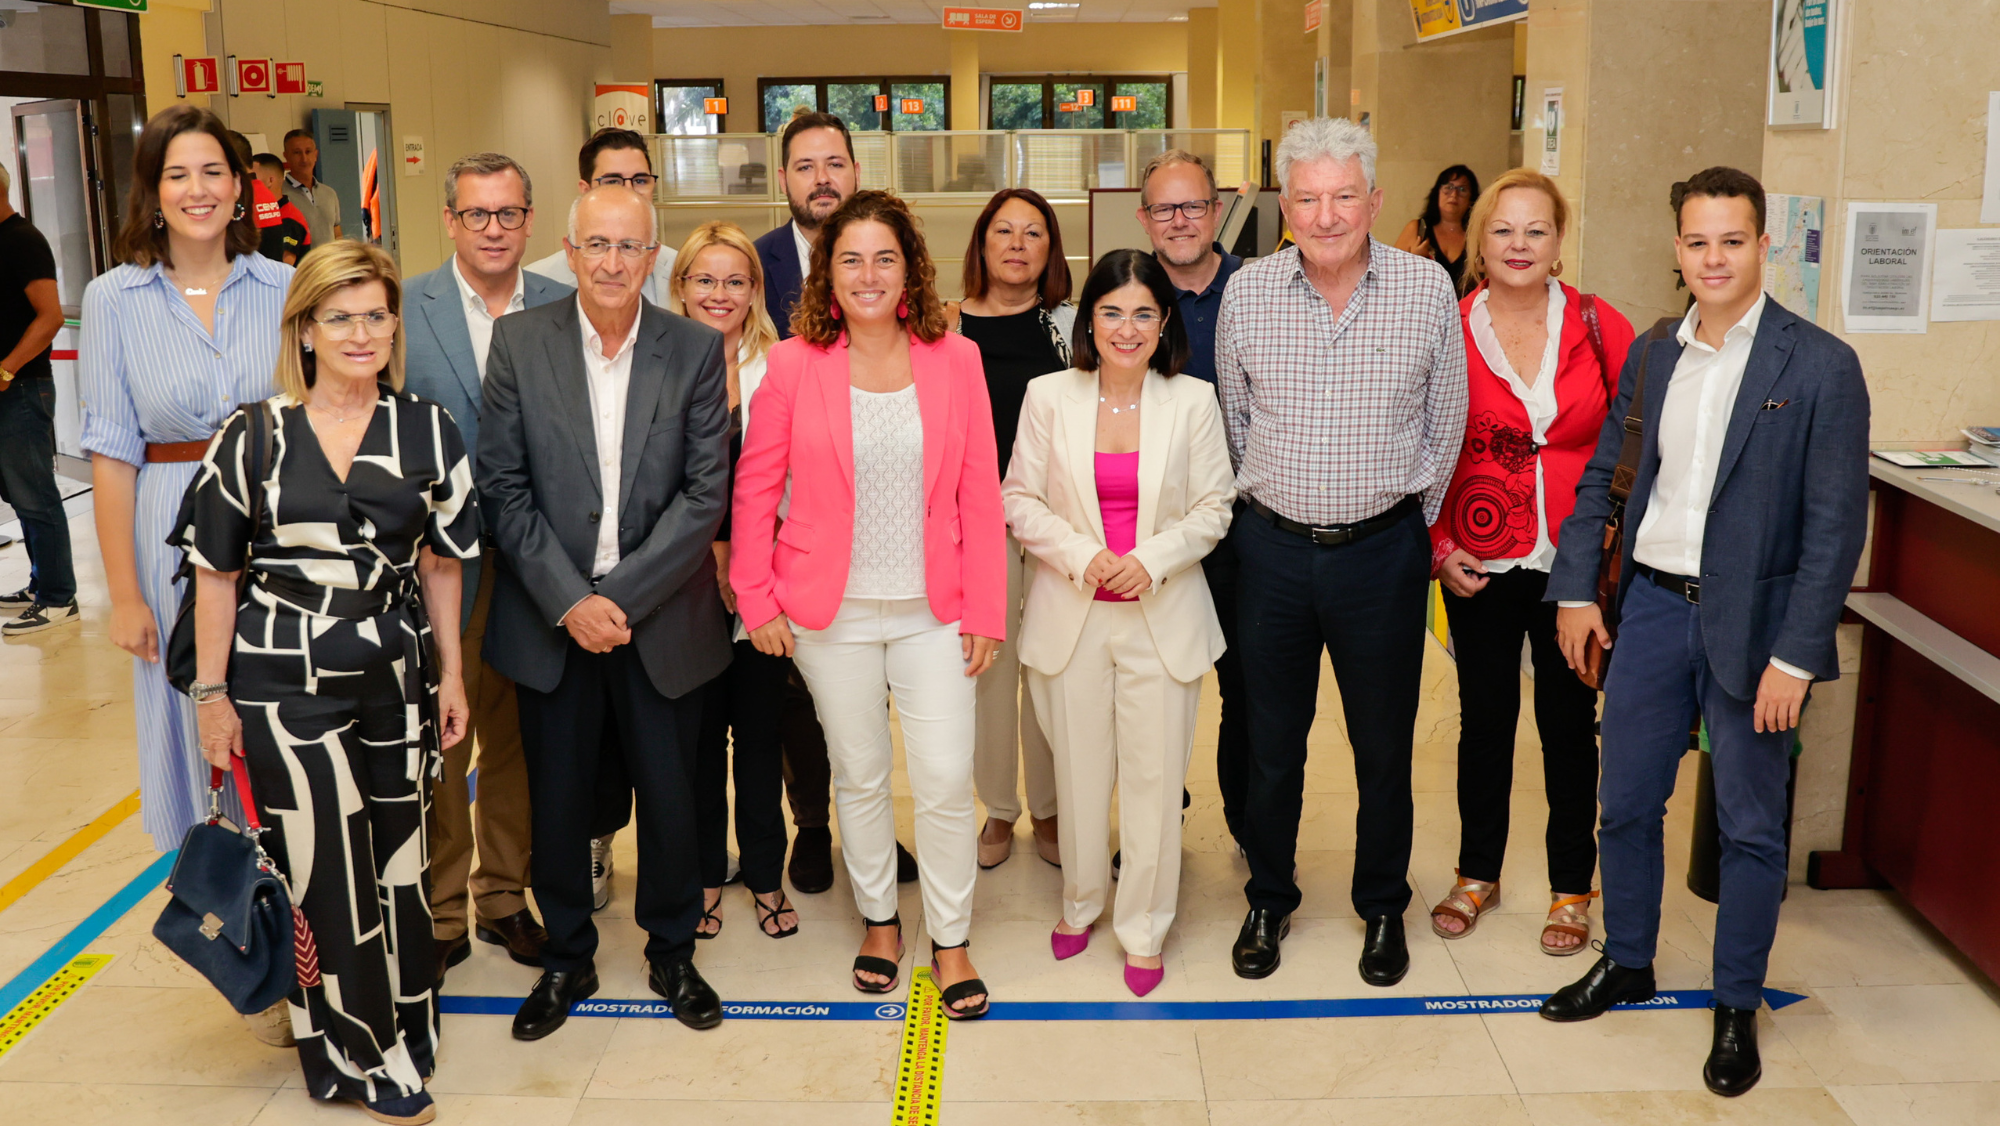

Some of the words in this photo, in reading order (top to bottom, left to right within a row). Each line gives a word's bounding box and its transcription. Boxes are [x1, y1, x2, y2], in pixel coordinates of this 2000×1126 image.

[879, 97, 885, 108] 2
[1083, 92, 1089, 103] 3
[713, 101, 719, 112] 1
[405, 143, 422, 151] ENTRADA
[1861, 247, 1917, 256] ORIENTACIÓN
[1869, 257, 1907, 265] LABORAL
[923, 994, 933, 1006] POR
[1425, 999, 1543, 1010] MOSTRADOR
[919, 1006, 932, 1027] FAVOR,
[916, 1027, 930, 1061] MANTENGA
[915, 1061, 926, 1071] LA
[911, 1071, 925, 1105] DISTANCIA
[909, 1105, 920, 1115] DE
